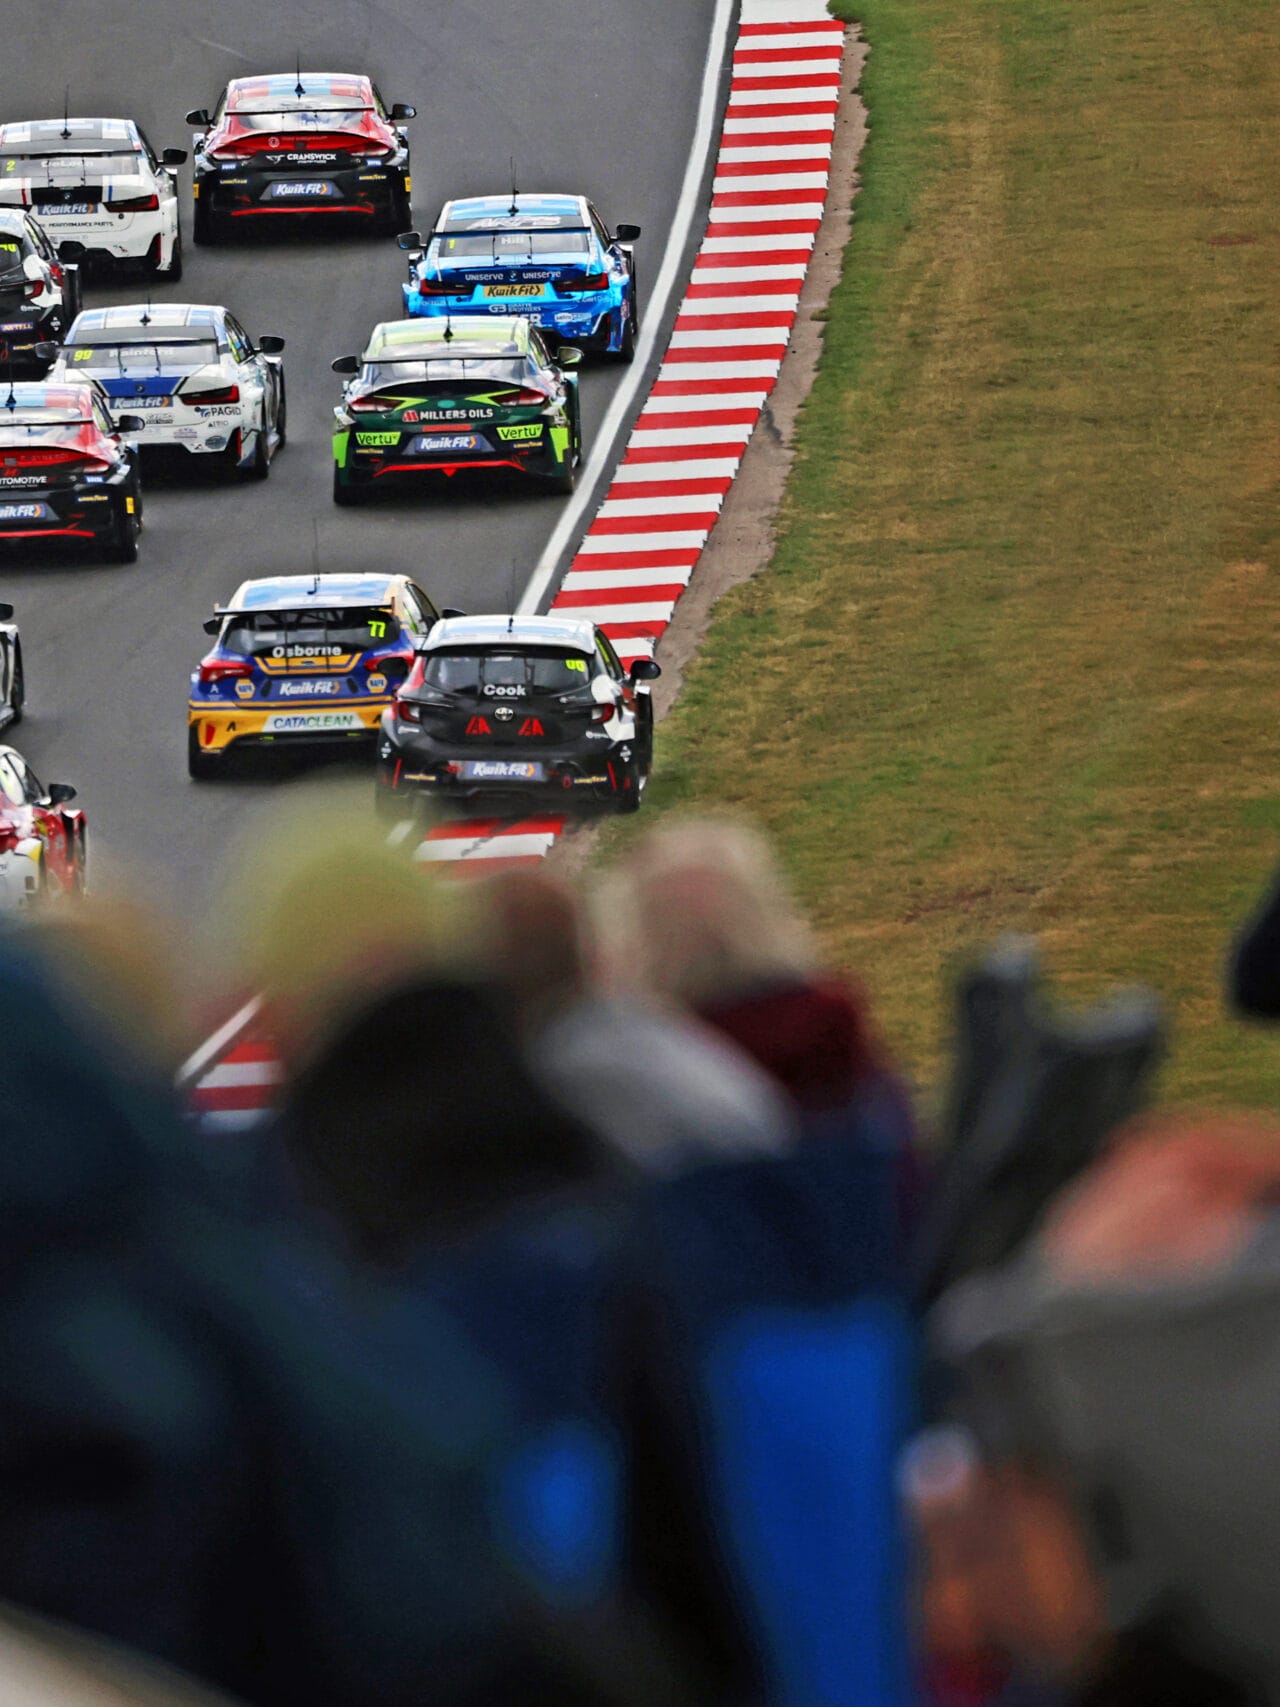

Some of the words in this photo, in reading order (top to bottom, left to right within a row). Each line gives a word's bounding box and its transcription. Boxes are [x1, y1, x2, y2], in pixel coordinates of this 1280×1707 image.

[286, 153, 337, 161] CRANSWICK
[6, 160, 16, 172] 2
[74, 349, 94, 361] 99
[211, 406, 241, 416] PAGID
[420, 410, 466, 421] MILLERS
[469, 409, 493, 418] OILS
[501, 426, 537, 439] Vertu
[359, 434, 394, 445] Vertu
[367, 620, 386, 638] 77
[272, 645, 343, 658] Osborne
[483, 684, 526, 697] Cook
[273, 715, 355, 729] CATACLEAN
